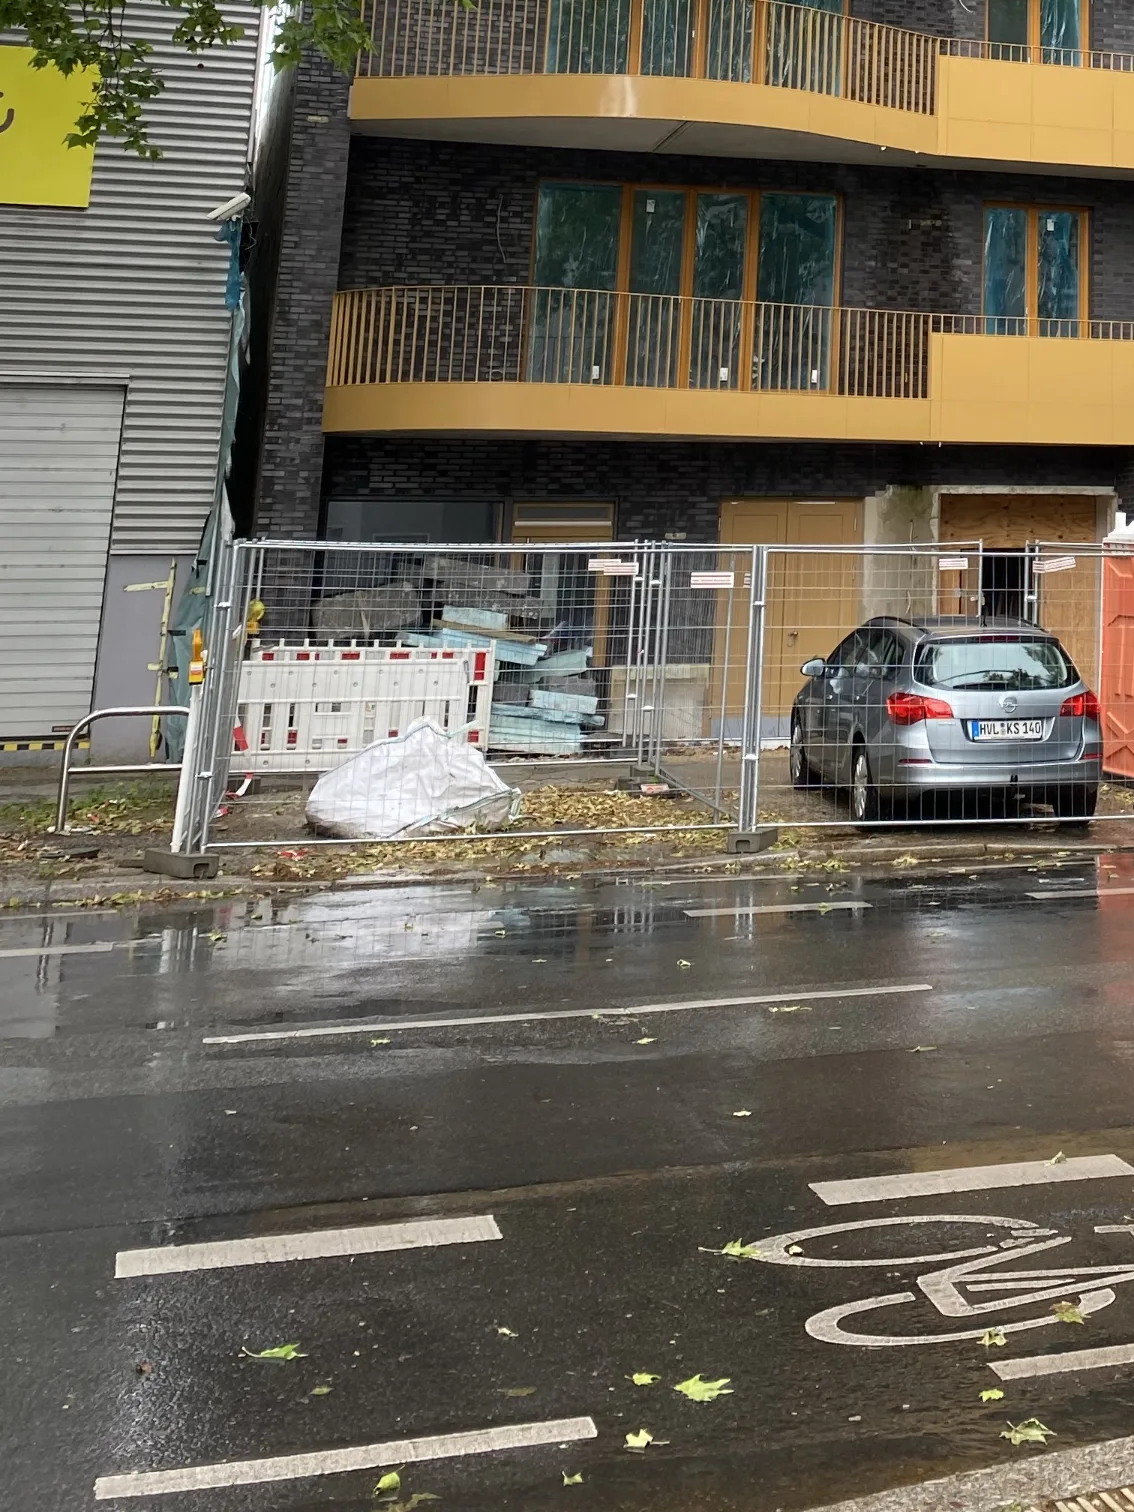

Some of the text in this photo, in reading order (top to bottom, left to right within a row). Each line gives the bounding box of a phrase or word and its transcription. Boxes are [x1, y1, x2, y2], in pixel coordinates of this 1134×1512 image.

[979, 722, 1041, 735] HVL KS 140
